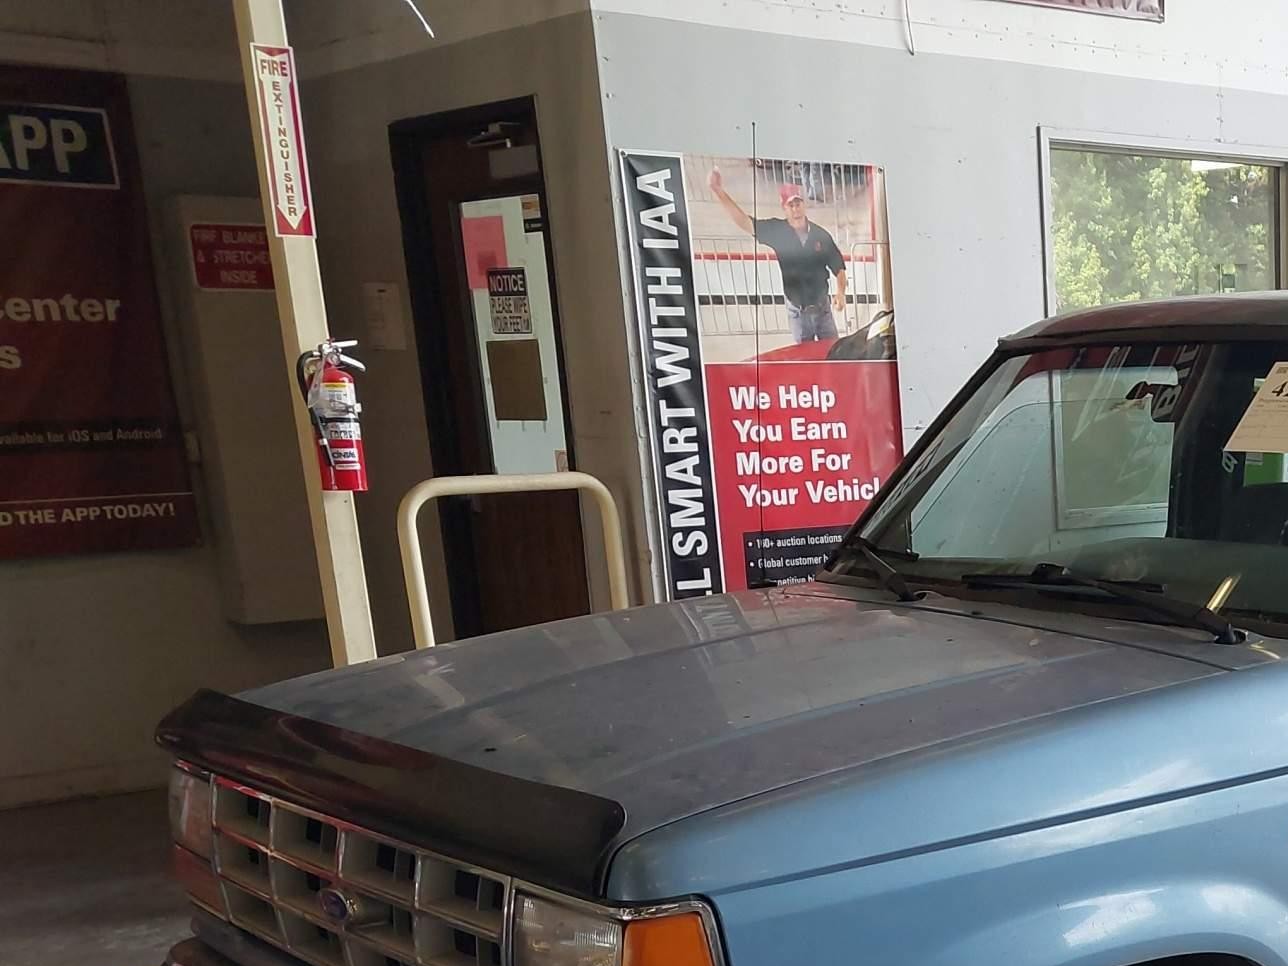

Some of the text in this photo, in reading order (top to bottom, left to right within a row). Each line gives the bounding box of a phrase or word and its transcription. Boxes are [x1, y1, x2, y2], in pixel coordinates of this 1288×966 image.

[261, 59, 289, 77] FIRE
[271, 81, 297, 216] EXTINGUISHER
[636, 168, 679, 249] IAA
[222, 231, 266, 244] BLANKE
[213, 250, 269, 265] STRETCHE
[489, 274, 526, 292] NOTICE
[0, 293, 121, 322] enter
[645, 267, 692, 388] WITH
[729, 384, 836, 413] We Help
[116, 428, 163, 440] Android
[732, 417, 847, 443] You Earn
[735, 448, 851, 475] More For
[659, 400, 708, 556] SMART
[738, 477, 881, 508] Your Vehicl
[14, 509, 57, 525] THE
[61, 506, 101, 522] APP
[102, 502, 176, 519] TODAY!
[776, 535, 806, 547] auction
[807, 533, 843, 545] locations
[785, 555, 823, 567] customer
